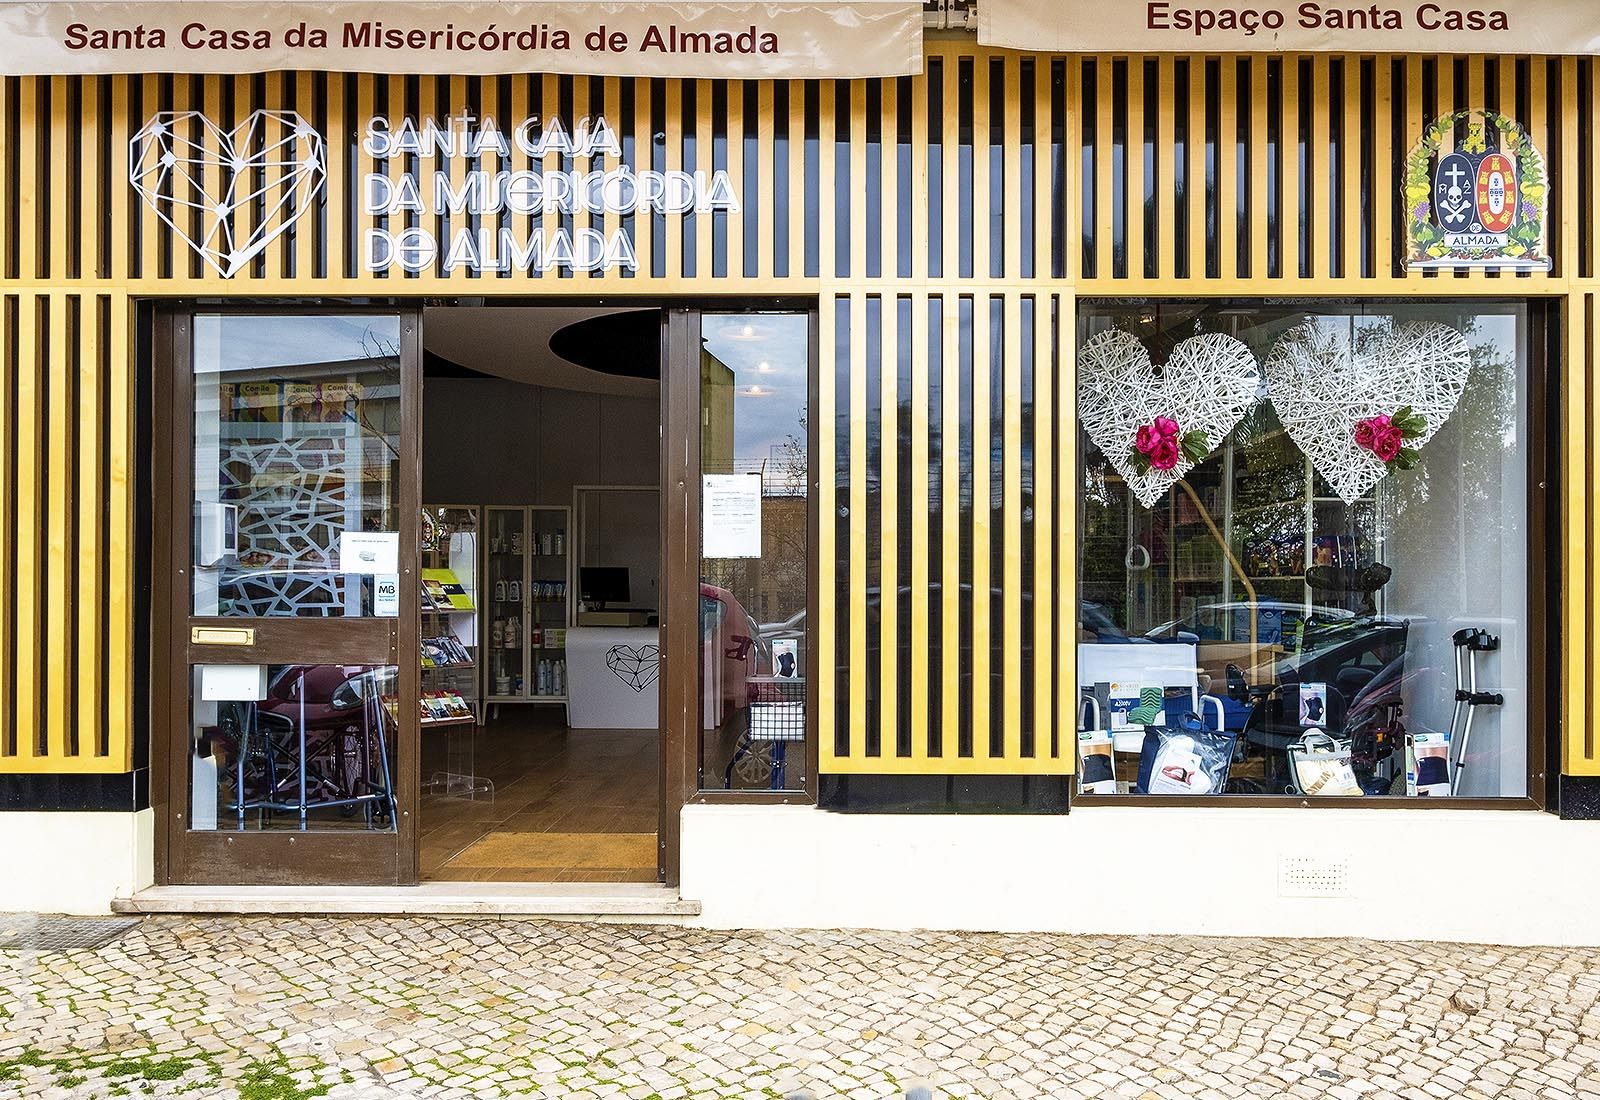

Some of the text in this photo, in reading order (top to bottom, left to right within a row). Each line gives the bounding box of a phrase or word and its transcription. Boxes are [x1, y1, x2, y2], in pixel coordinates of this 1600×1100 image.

[1147, 1, 1509, 35] Espaço Santa Casa
[64, 22, 779, 53] Santa Casa da Misericórdia de Almada
[364, 171, 426, 215] DA
[442, 228, 640, 272] ALMADA
[1452, 235, 1500, 246] ALMADA
[379, 585, 396, 594] MB
